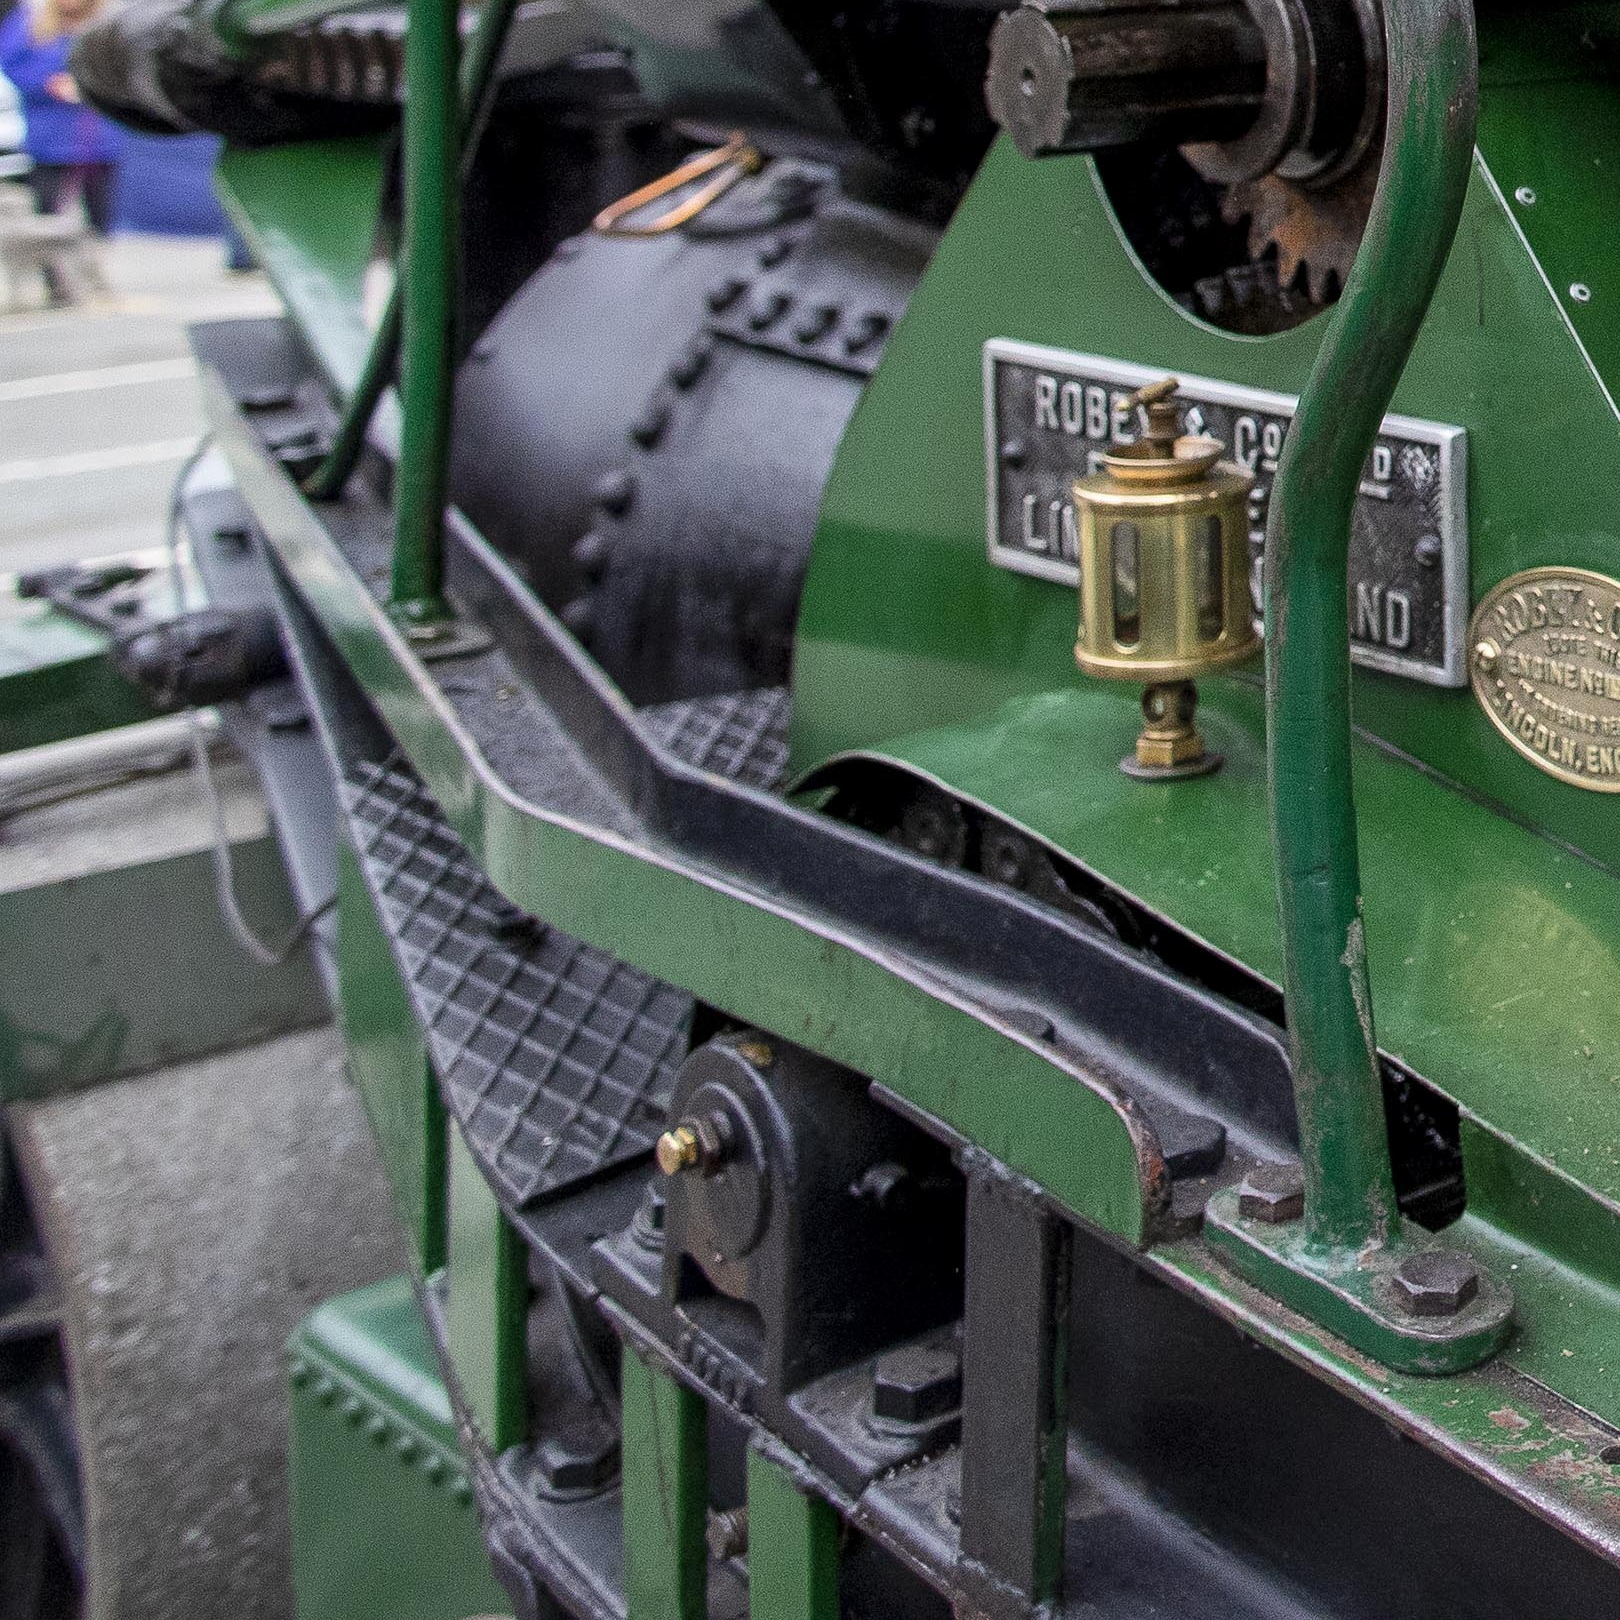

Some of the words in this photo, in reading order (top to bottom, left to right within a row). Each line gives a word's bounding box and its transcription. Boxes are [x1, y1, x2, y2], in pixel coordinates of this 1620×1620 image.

[1573, 598, 1604, 634] &
[1505, 649, 1578, 691] ENGINE
[1492, 678, 1584, 771] LINCOLN,
